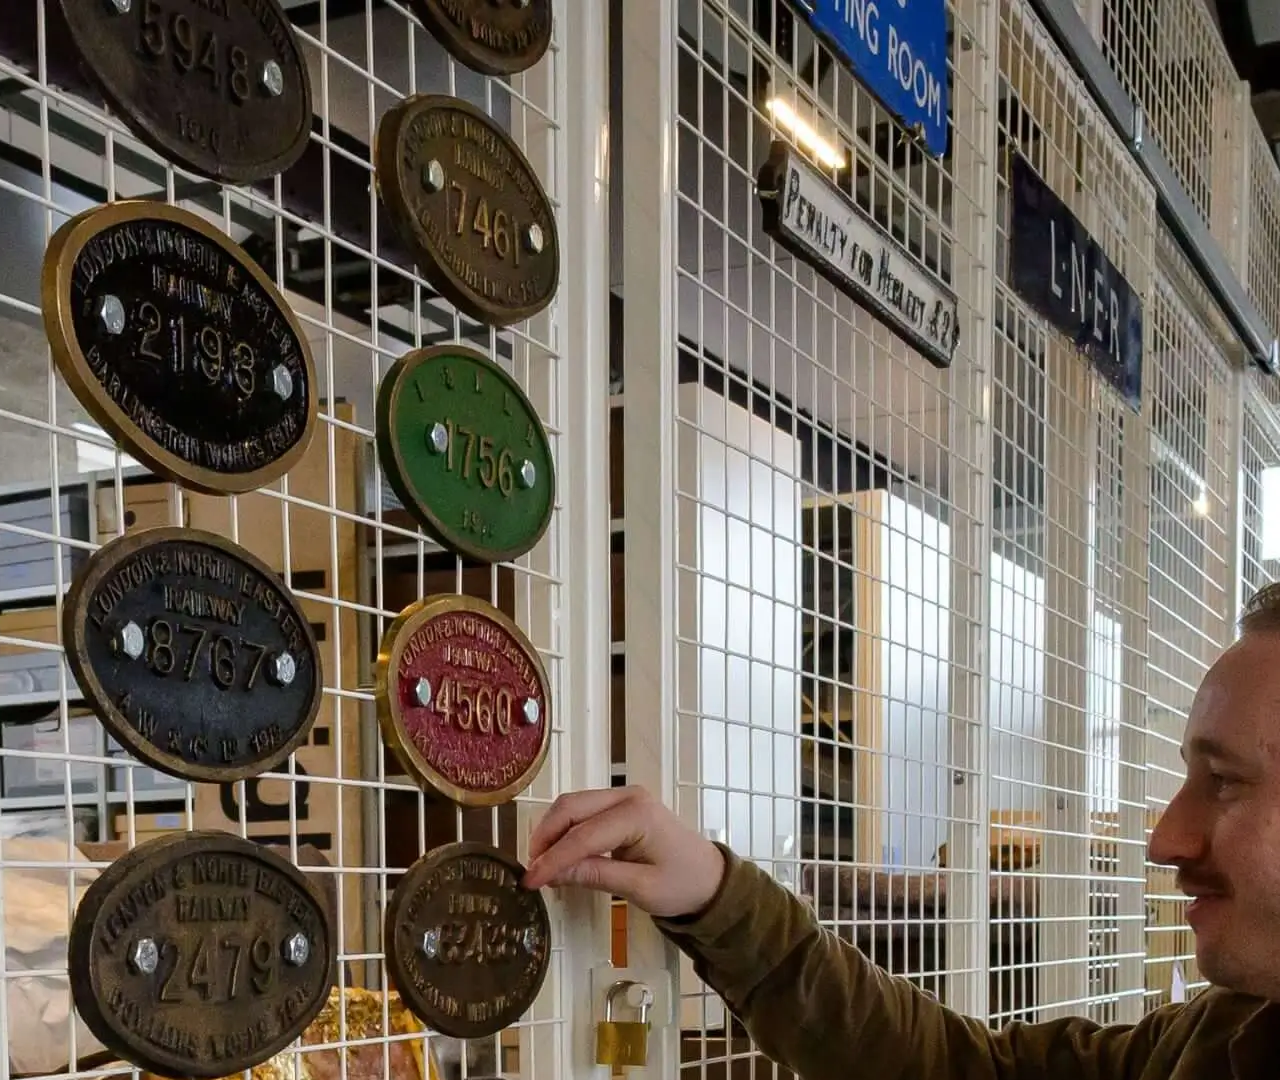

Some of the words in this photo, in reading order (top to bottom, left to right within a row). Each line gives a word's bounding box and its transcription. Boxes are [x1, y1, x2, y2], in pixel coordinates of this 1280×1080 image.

[142, 0, 249, 100] 5948
[888, 24, 941, 127] ROOM
[75, 227, 140, 294] LONDON
[141, 228, 155, 253] &
[156, 228, 220, 277] NORTH
[450, 180, 520, 268] 7461
[785, 168, 848, 261] PENALTY
[851, 242, 874, 286] FOR
[877, 247, 926, 329] NEGLECT
[928, 300, 951, 348] £2
[87, 345, 200, 464] DARLINGTON
[444, 416, 513, 498] 1756
[89, 552, 155, 628] LONDON
[156, 552, 169, 573] &
[173, 551, 237, 586] NORTH
[163, 584, 247, 627] RAILWAY
[147, 619, 269, 692] 8767
[398, 620, 444, 678] LONDON
[434, 675, 513, 736] 4560
[456, 764, 498, 787] WORKS
[159, 934, 274, 1005] 2479
